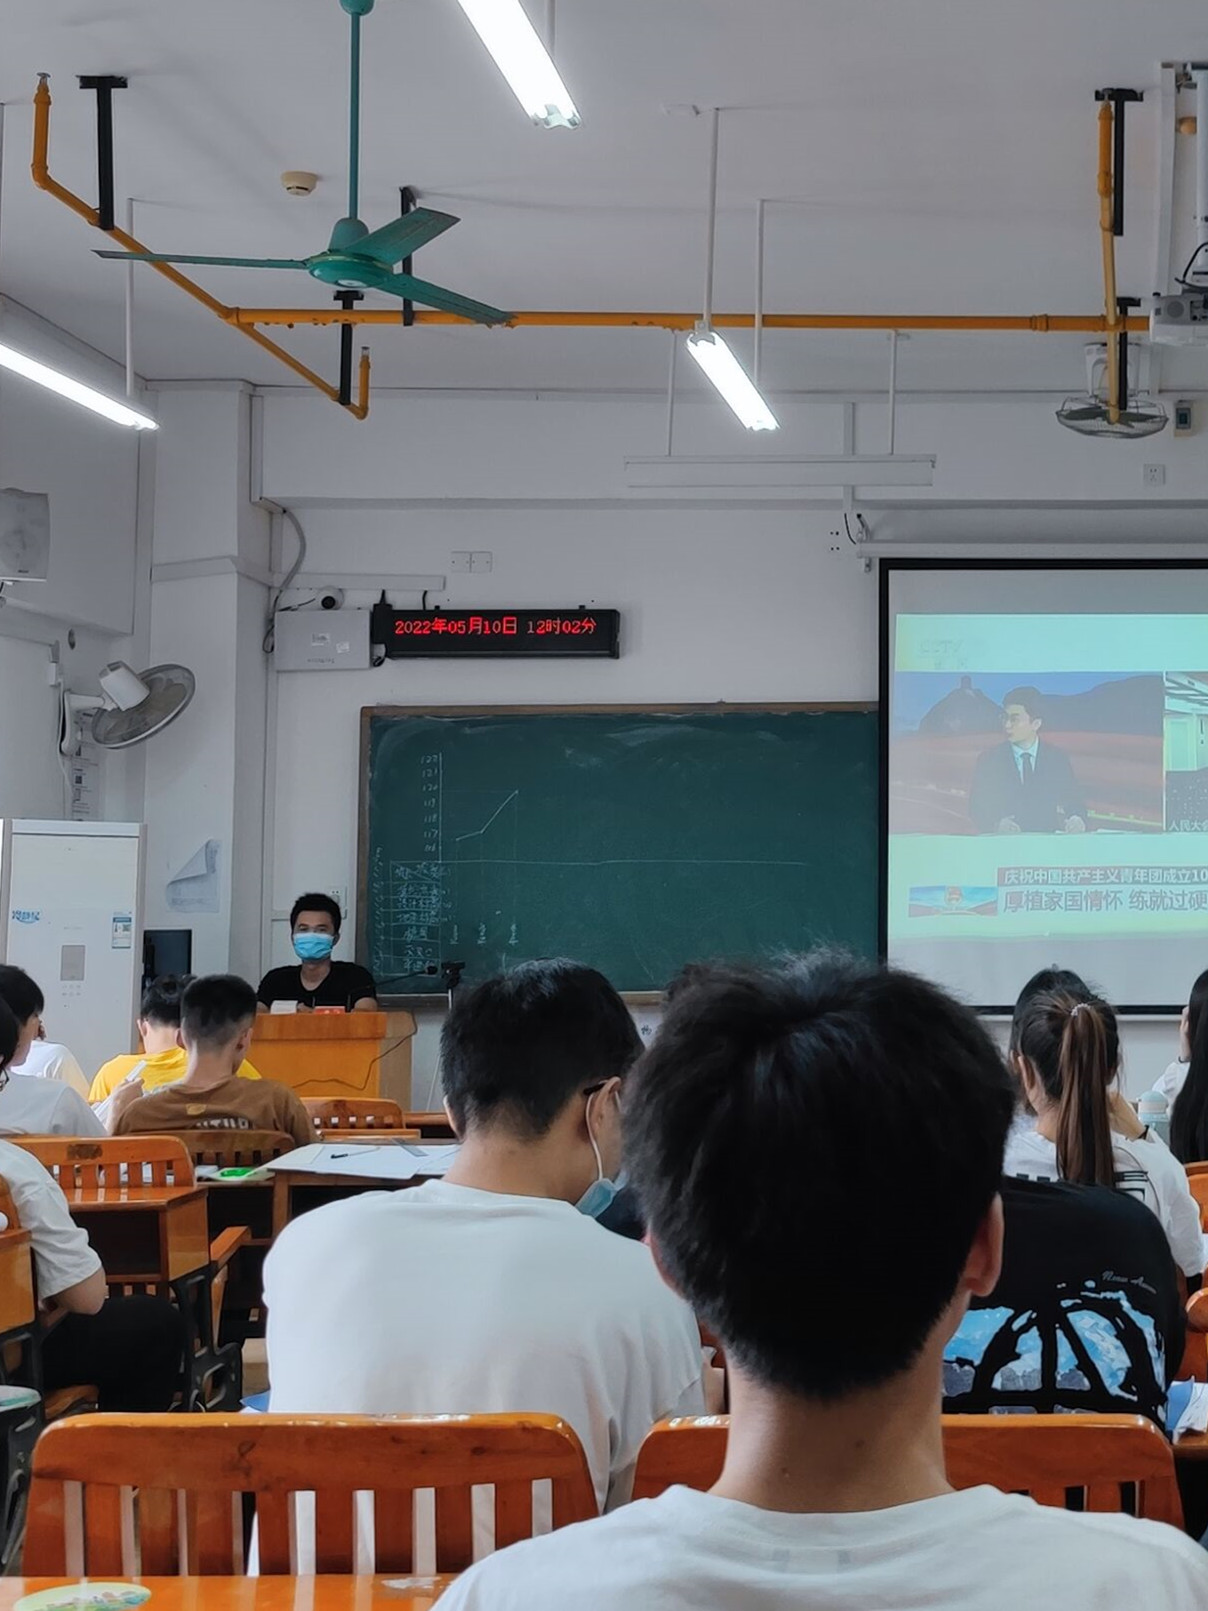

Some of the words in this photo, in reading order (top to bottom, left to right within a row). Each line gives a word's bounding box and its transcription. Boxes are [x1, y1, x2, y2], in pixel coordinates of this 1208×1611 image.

[395, 617, 518, 635] 2022年05月10日
[526, 617, 597, 635] 12时02分
[1003, 889, 1123, 912] 厚植家国情怀
